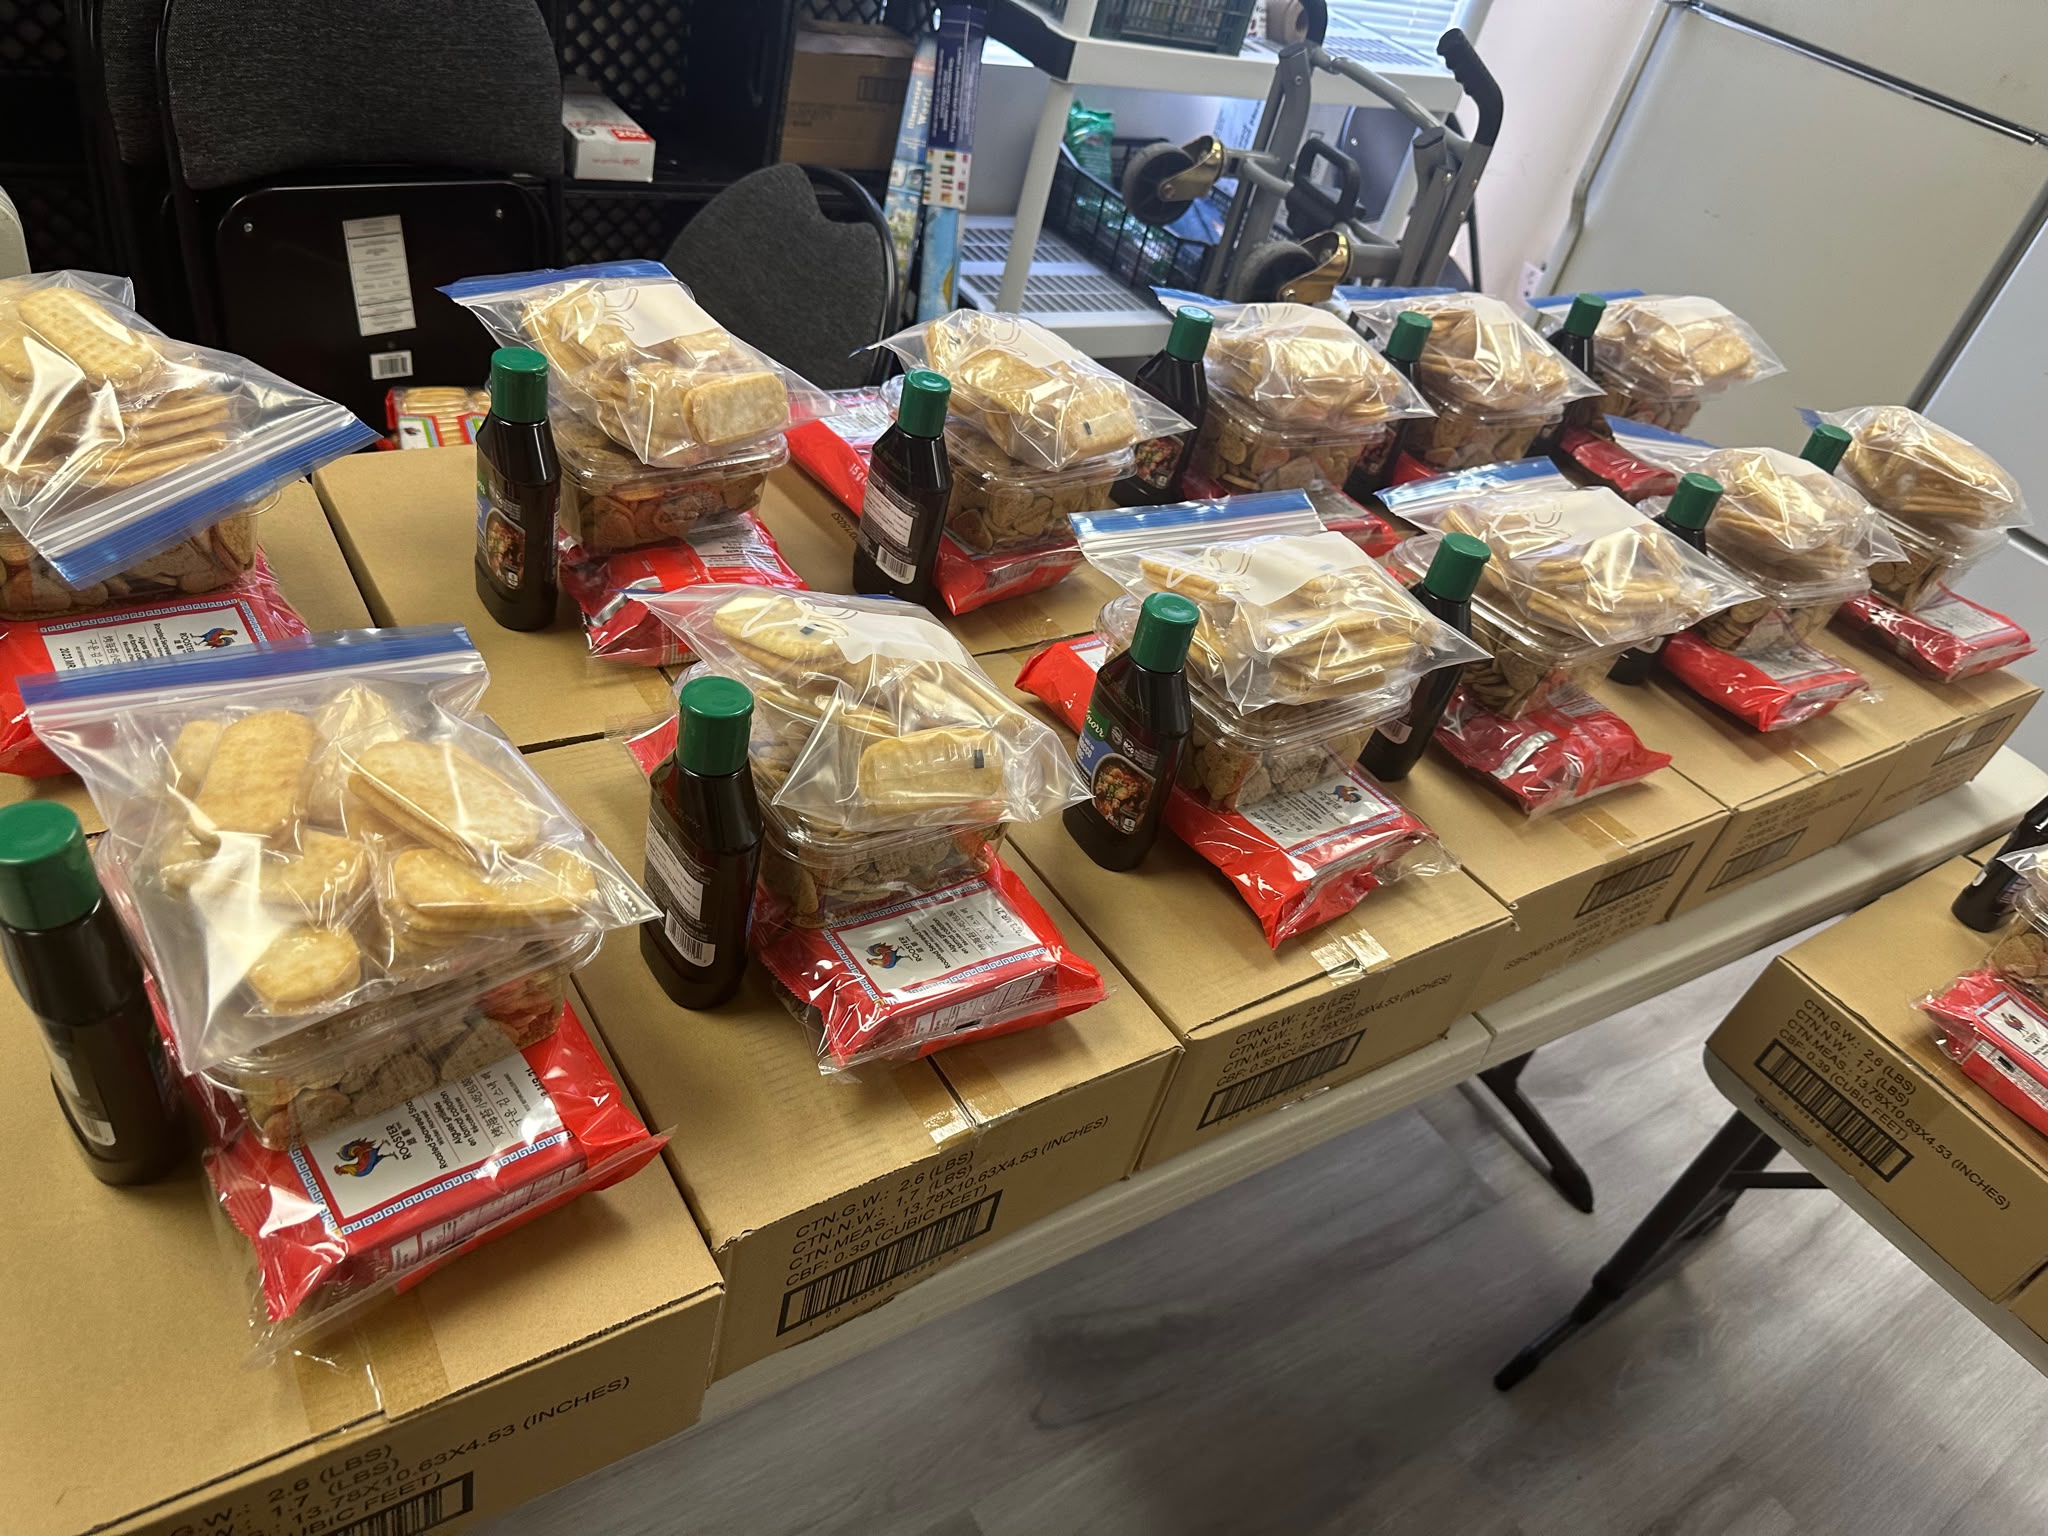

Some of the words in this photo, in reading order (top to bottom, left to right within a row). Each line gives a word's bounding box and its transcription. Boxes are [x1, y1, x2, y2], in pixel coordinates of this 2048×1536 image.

[180, 632, 194, 652] ROOSTE
[898, 936, 922, 961] ROOSTER
[1235, 1013, 1300, 1045] CTN.G.W.:
[1301, 1016, 1319, 1031] 1.7
[1795, 1009, 1851, 1058] CTN.N.W.:
[1856, 1060, 1874, 1075] 1.7
[1876, 1077, 1910, 1107] (LBS)
[1804, 999, 1860, 1049] CTN.G.W.:
[1863, 1049, 1884, 1067] 2.6
[1882, 1065, 1916, 1096] (LBS)
[1779, 1029, 1806, 1054] CBF:
[1806, 1051, 1831, 1074] 0.39
[1830, 1072, 1873, 1109] (CUBIC
[1871, 1107, 1909, 1141] FEET)
[404, 1101, 417, 1112] Sna
[431, 1101, 451, 1122] grillées
[439, 1091, 459, 1116] collation
[495, 1097, 511, 1106] 김
[502, 1107, 523, 1126] 구운
[1787, 1019, 1853, 1076] CTN.MEAS.:
[1855, 1075, 1953, 1160] 13.78X10.63X4.53
[1951, 1159, 2011, 1211] (INCHES)
[384, 1124, 412, 1159] ROOSTER
[411, 1113, 433, 1142] Seaweed
[444, 1122, 463, 1143] Algues
[453, 1117, 471, 1137] format
[467, 1137, 477, 1145] en
[427, 1142, 447, 1168] Roasted
[788, 1215, 895, 1271] CTN.MEAS.:
[903, 1148, 1038, 1218] 13.78X10.63X4.53
[1041, 1115, 1109, 1156] (INCHES)
[796, 1190, 889, 1239] CTN.G.W.:
[900, 1172, 924, 1193] 2.6
[929, 1151, 974, 1180] (LBS)
[792, 1207, 883, 1254] CTN.N.W.:
[897, 1188, 920, 1207] 1.7
[928, 1165, 973, 1194] (LBS)
[785, 1259, 828, 1287] CBF:
[834, 1239, 870, 1265] 0.39
[875, 1207, 935, 1247] (CUBIC
[940, 1184, 987, 1215] FEET)
[292, 1423, 515, 1525] 13.78X10.63X4.53
[523, 1376, 630, 1430] (INCHES)
[268, 1479, 310, 1504] 2.6
[319, 1444, 392, 1485] (LBS)
[271, 1493, 309, 1517] 1.7
[327, 1457, 400, 1497] (LBS)
[363, 1472, 441, 1512] FEET)
